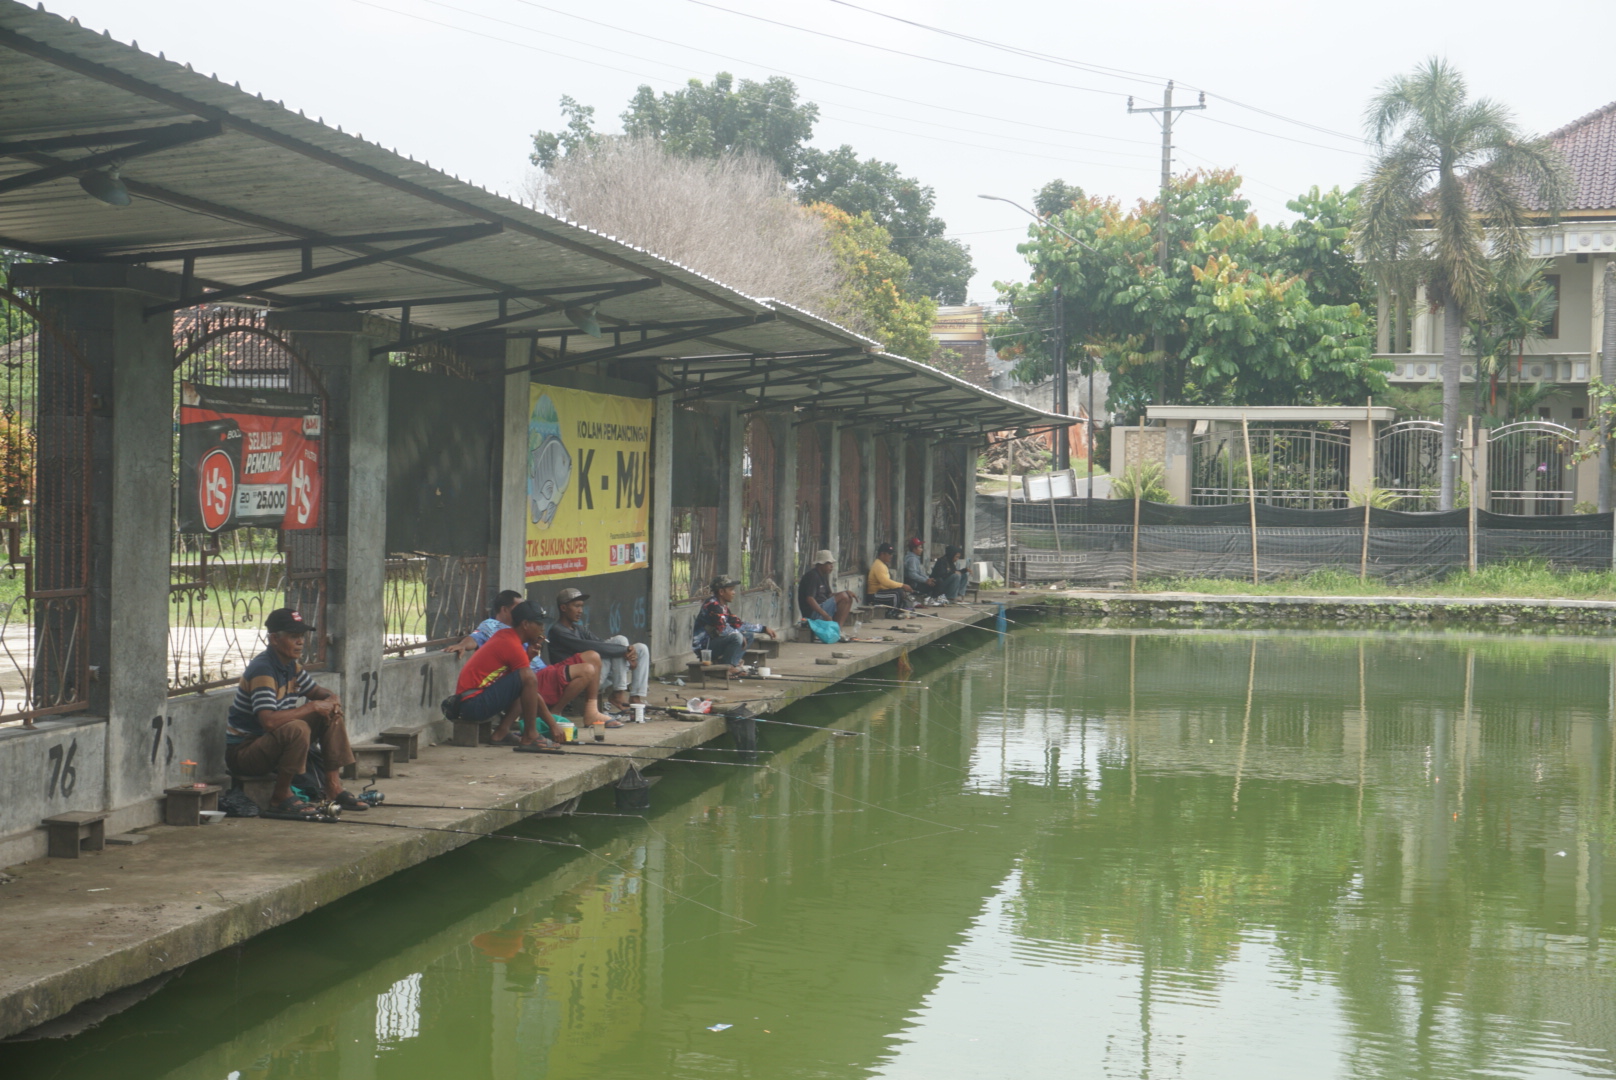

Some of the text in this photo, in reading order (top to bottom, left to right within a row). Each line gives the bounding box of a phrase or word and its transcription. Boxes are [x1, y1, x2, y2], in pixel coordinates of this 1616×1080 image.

[577, 420, 602, 440] KOLAM
[244, 451, 283, 474] PEMENANG
[577, 448, 596, 510] K
[616, 450, 647, 509] MU
[205, 467, 227, 515] HS
[240, 492, 250, 504] 20
[291, 459, 311, 524] HS
[540, 538, 566, 556] SUKUN
[565, 536, 588, 554] SUPER
[361, 670, 379, 716] 72
[48, 737, 77, 800] 76
